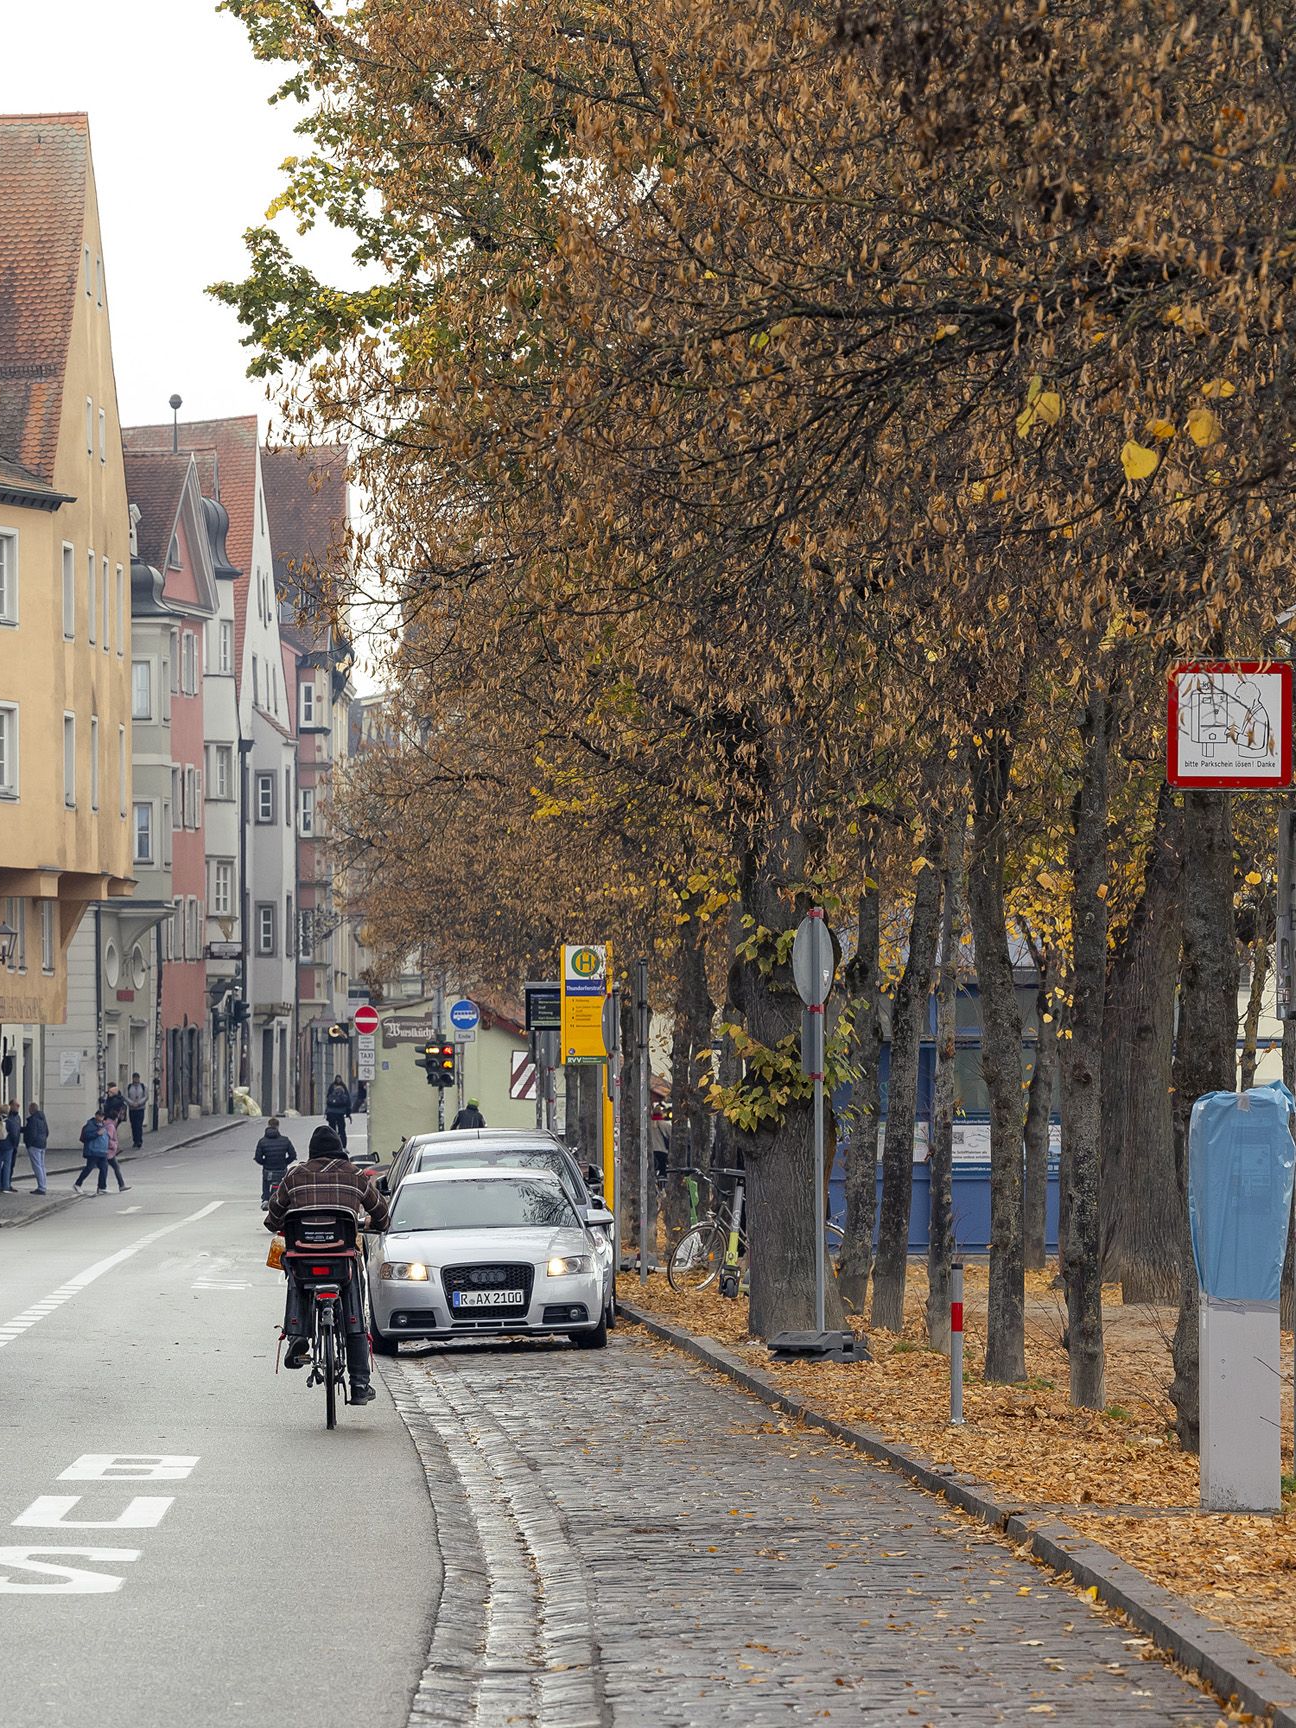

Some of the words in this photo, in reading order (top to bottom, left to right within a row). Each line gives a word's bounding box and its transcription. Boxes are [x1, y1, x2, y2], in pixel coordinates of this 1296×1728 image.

[1184, 760, 1198, 768] bitte
[1201, 760, 1233, 768] Parkschein
[1257, 760, 1276, 768] Danke
[460, 1293, 468, 1305] R
[476, 1292, 491, 1305] AX
[493, 1291, 522, 1304] 2100
